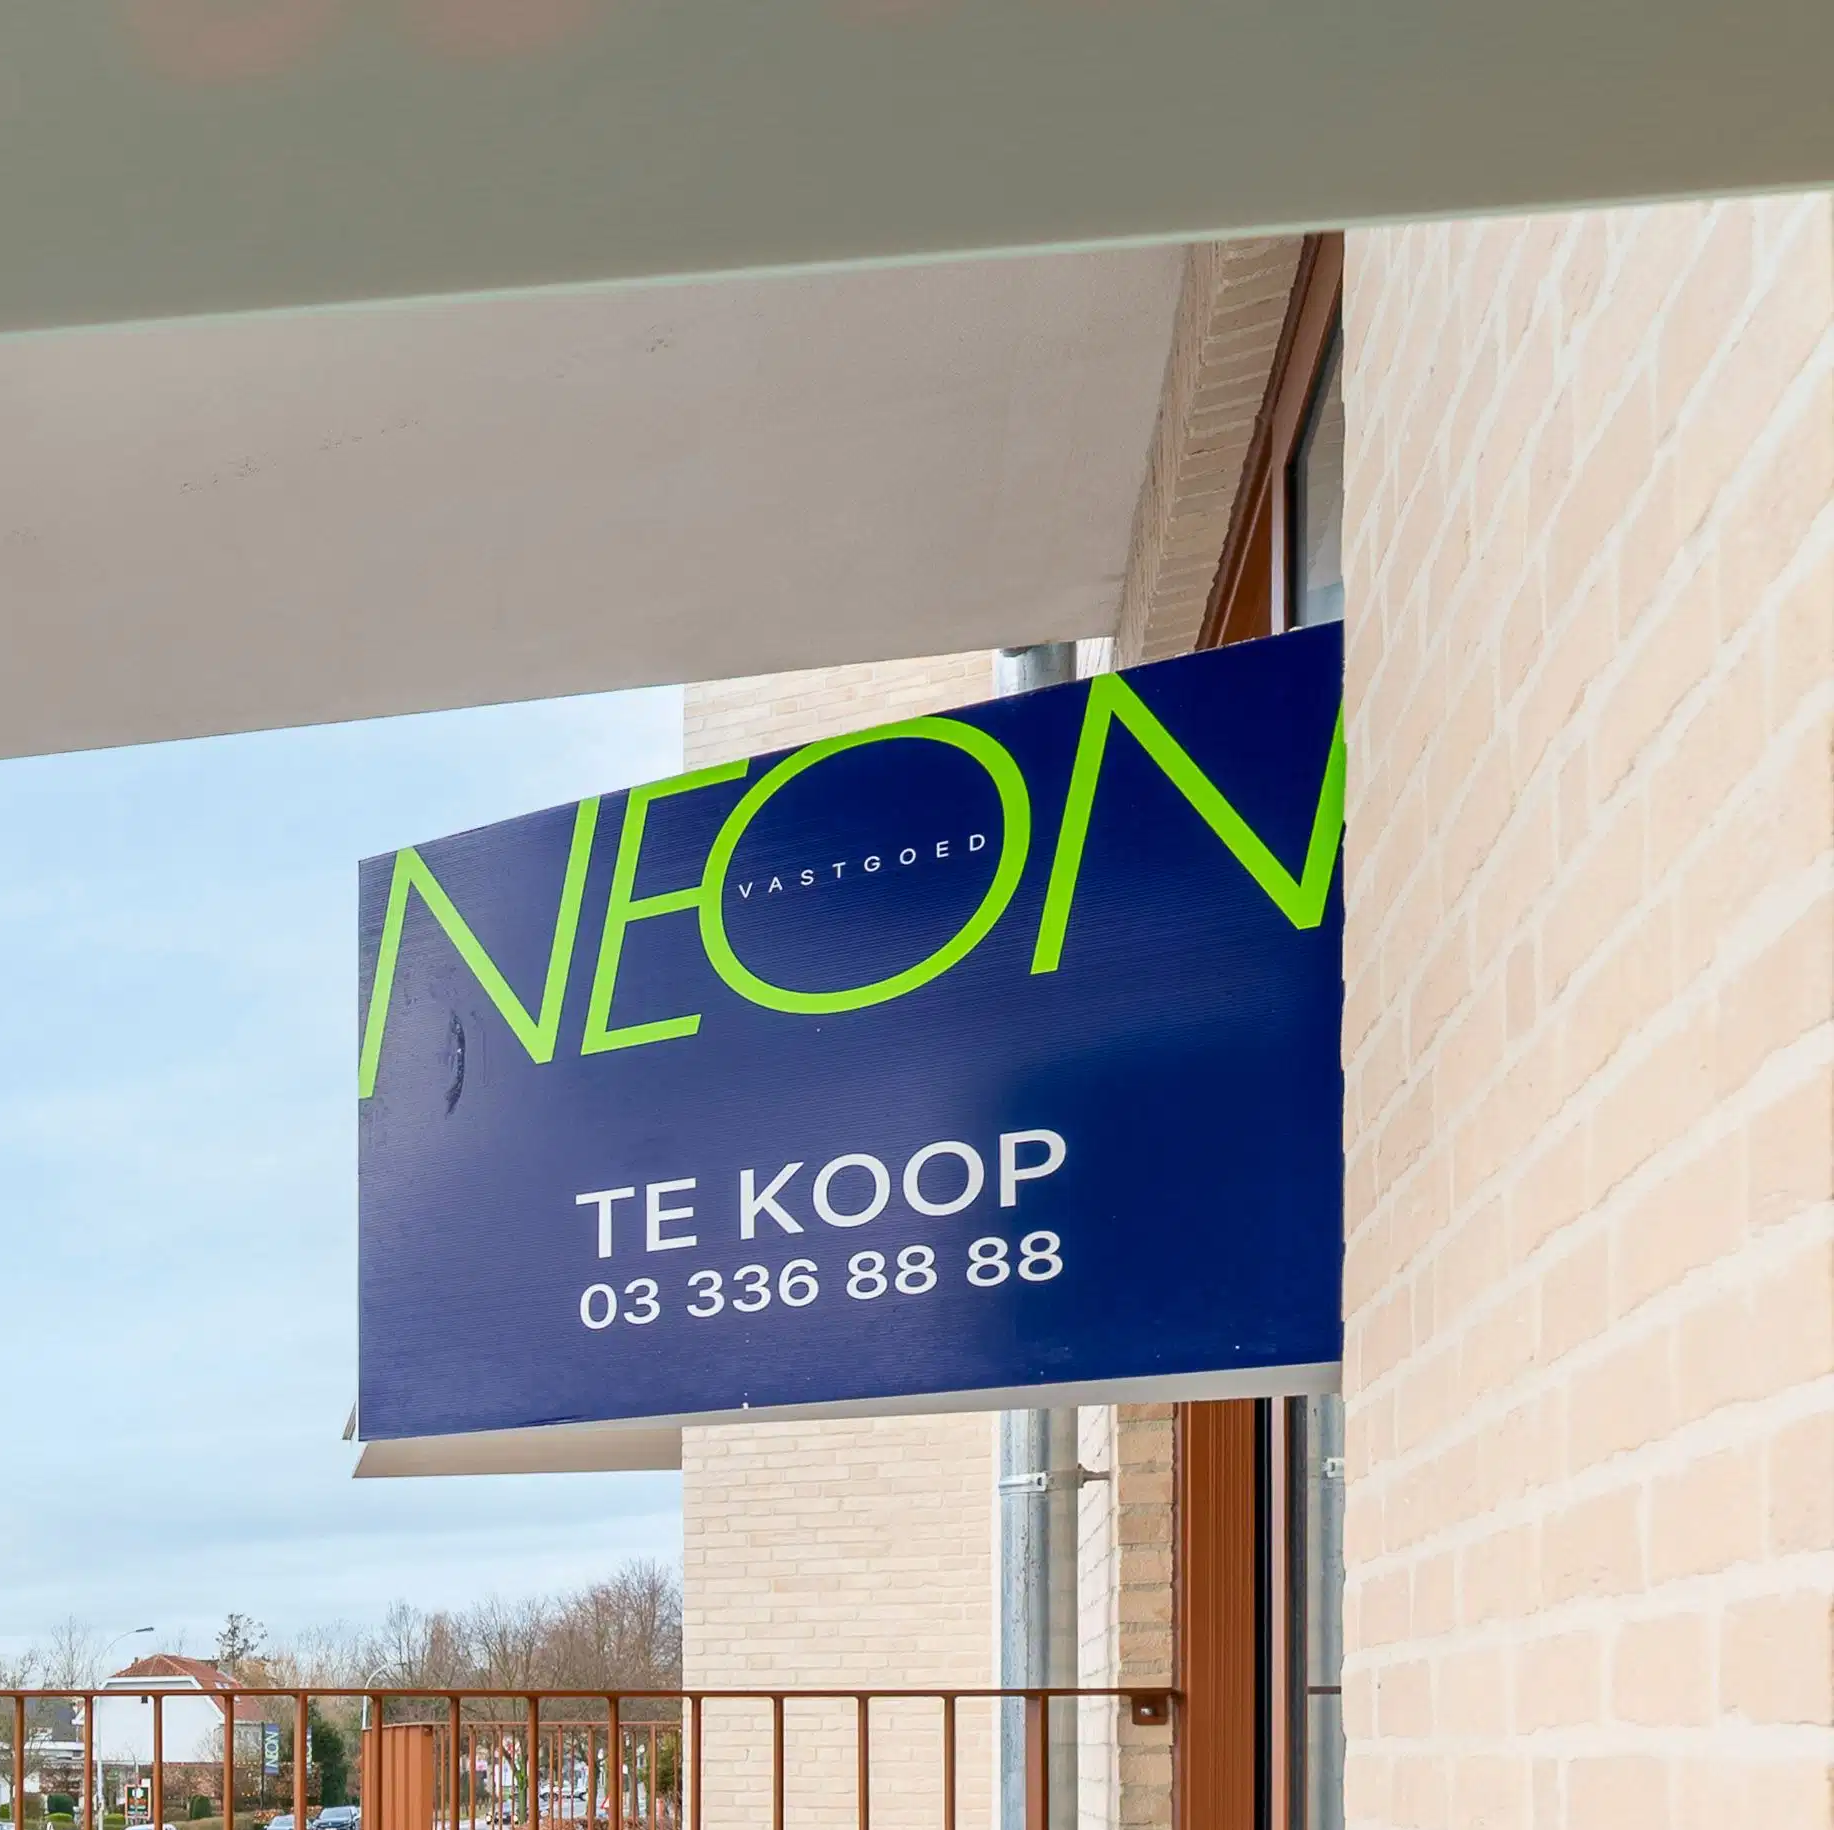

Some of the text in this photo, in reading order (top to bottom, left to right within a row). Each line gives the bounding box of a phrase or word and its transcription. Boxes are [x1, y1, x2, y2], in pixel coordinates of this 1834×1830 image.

[358, 673, 1344, 1098] NEON
[738, 833, 986, 899] VASTGOED
[575, 1128, 1067, 1259] TE KOOP
[578, 1230, 1064, 1330] 03 336 88 88
[264, 1730, 280, 1768] NEON
